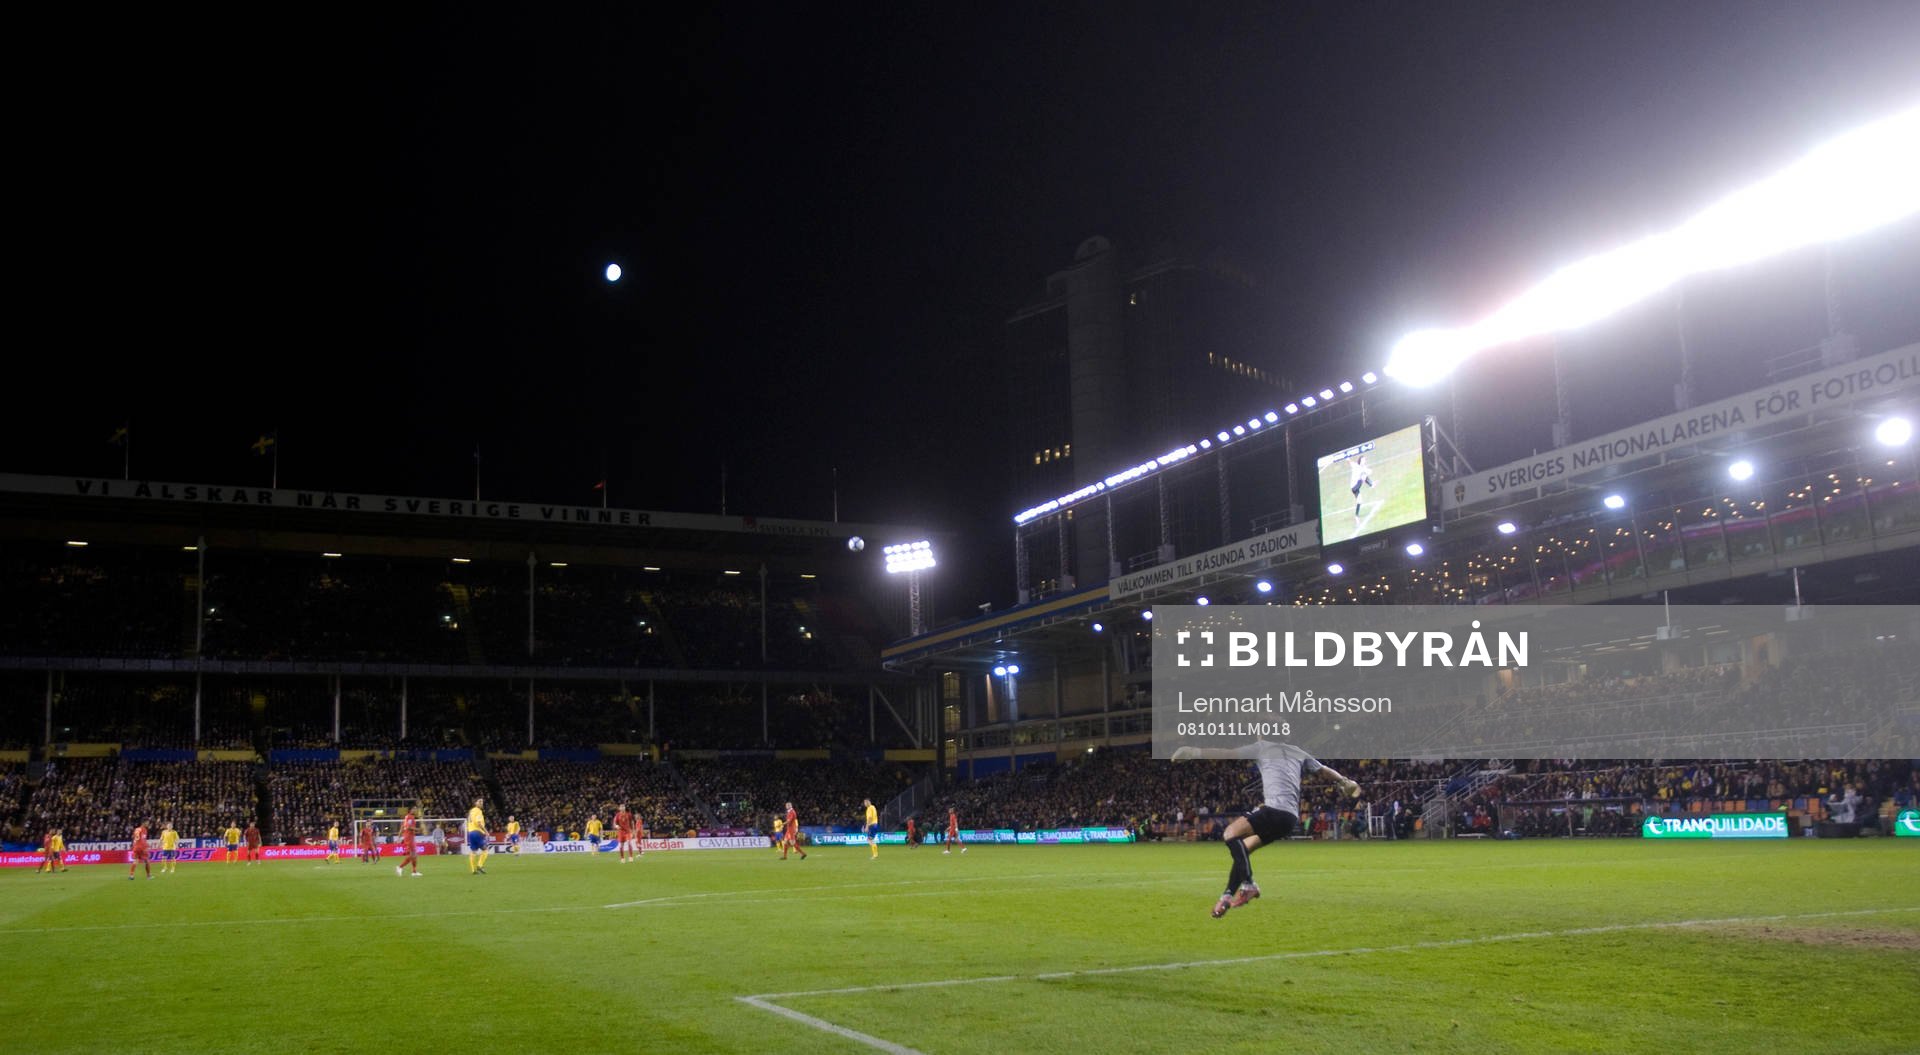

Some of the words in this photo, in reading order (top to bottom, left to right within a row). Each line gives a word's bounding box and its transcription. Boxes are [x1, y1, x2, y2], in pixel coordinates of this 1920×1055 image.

[1487, 456, 1566, 493] SVERIGES
[1572, 406, 1745, 470] NATIONALARENA
[1754, 389, 1801, 419] FÖR
[1810, 356, 1920, 405] FOTBOLL
[76, 480, 109, 496] VI
[135, 481, 274, 505] ÄLSKAR
[297, 491, 361, 510] NÄR
[385, 498, 520, 518] SVERIGE
[541, 507, 652, 526] VINNER
[1117, 567, 1174, 595] VÄLKOMMEN
[1177, 564, 1193, 578] TILL
[1196, 548, 1245, 573] RÅSUNDA
[1249, 531, 1298, 559] STADION
[1663, 816, 1786, 833] TRANQUILIDADE
[68, 841, 132, 851] STRYKTIPSET
[544, 841, 585, 853] Dustin
[698, 837, 765, 848] CAVALIERE
